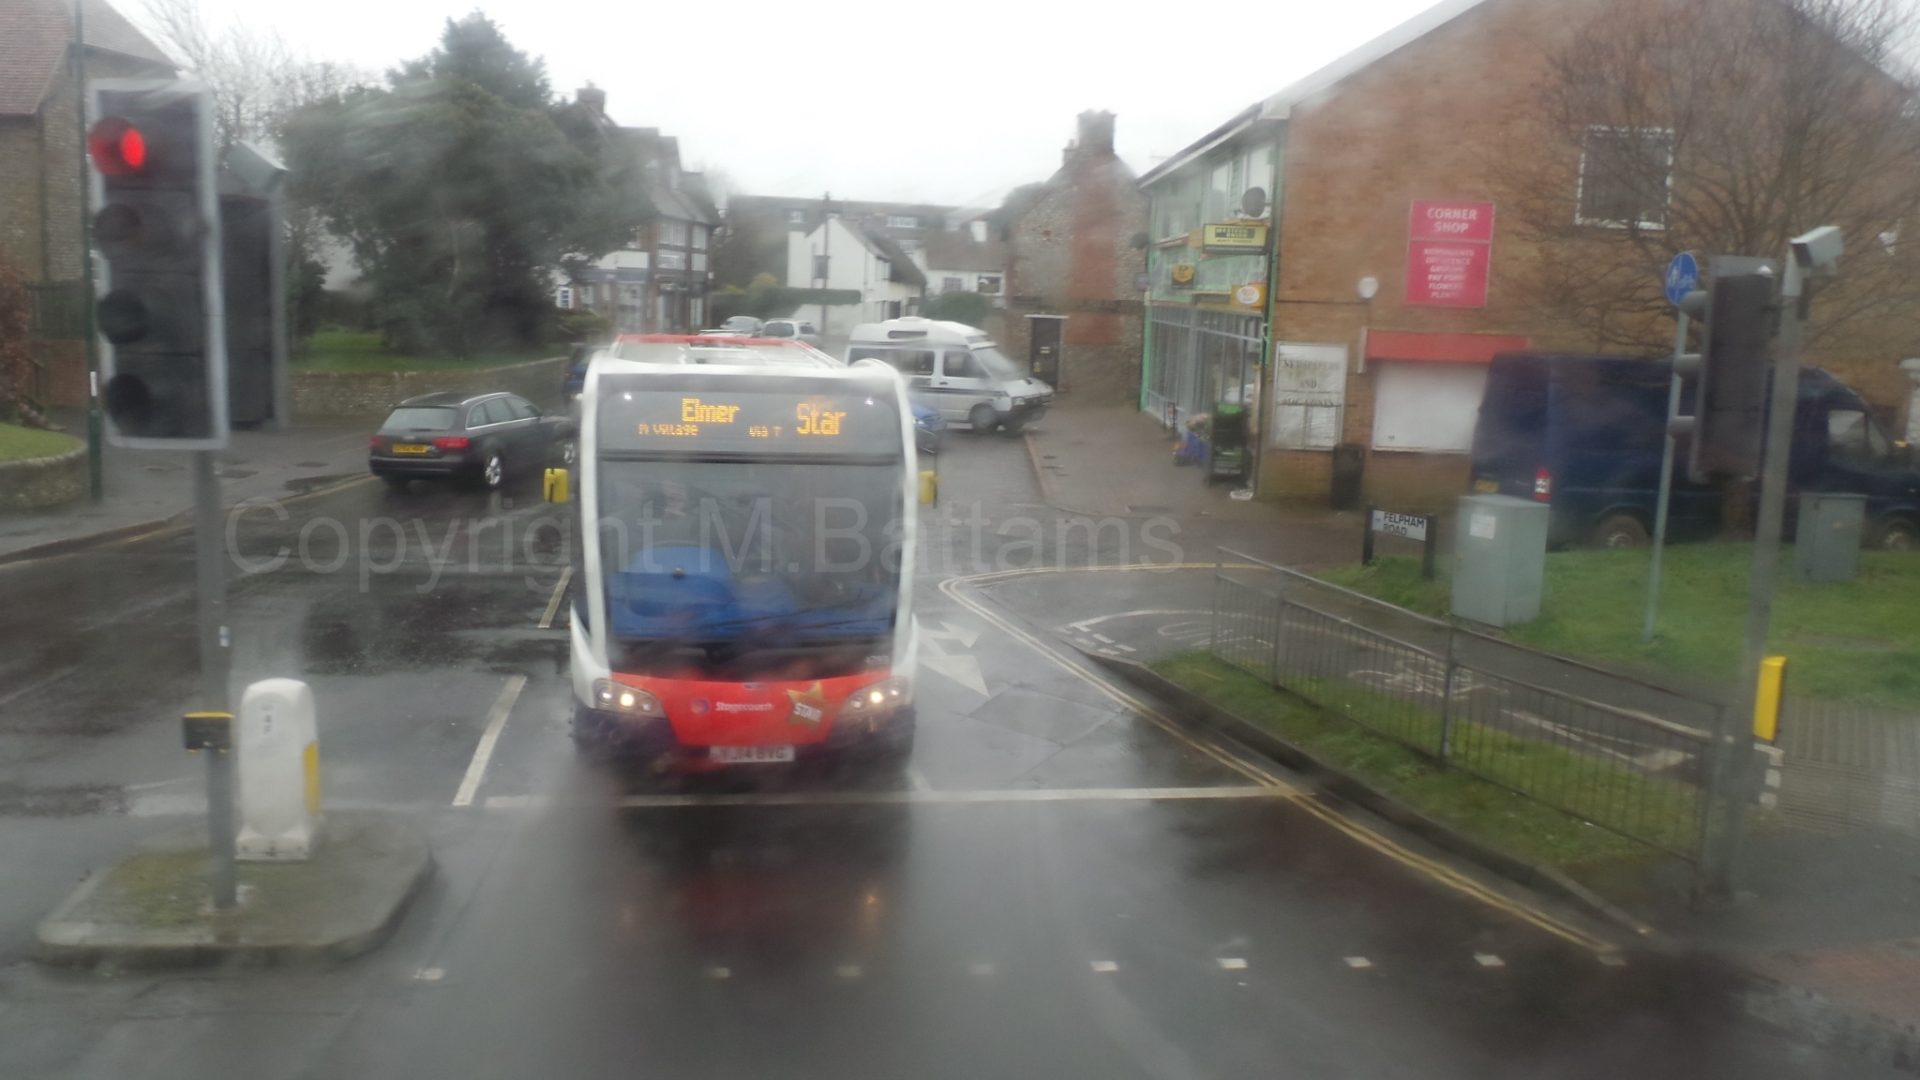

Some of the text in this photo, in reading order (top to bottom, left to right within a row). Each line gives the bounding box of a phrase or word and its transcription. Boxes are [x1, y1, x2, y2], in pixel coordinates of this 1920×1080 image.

[1427, 207, 1477, 220] CORNER
[1433, 221, 1469, 233] SHOP
[682, 398, 740, 423] Elmer
[797, 402, 847, 435] Star
[1384, 512, 1425, 528] FELPHAM
